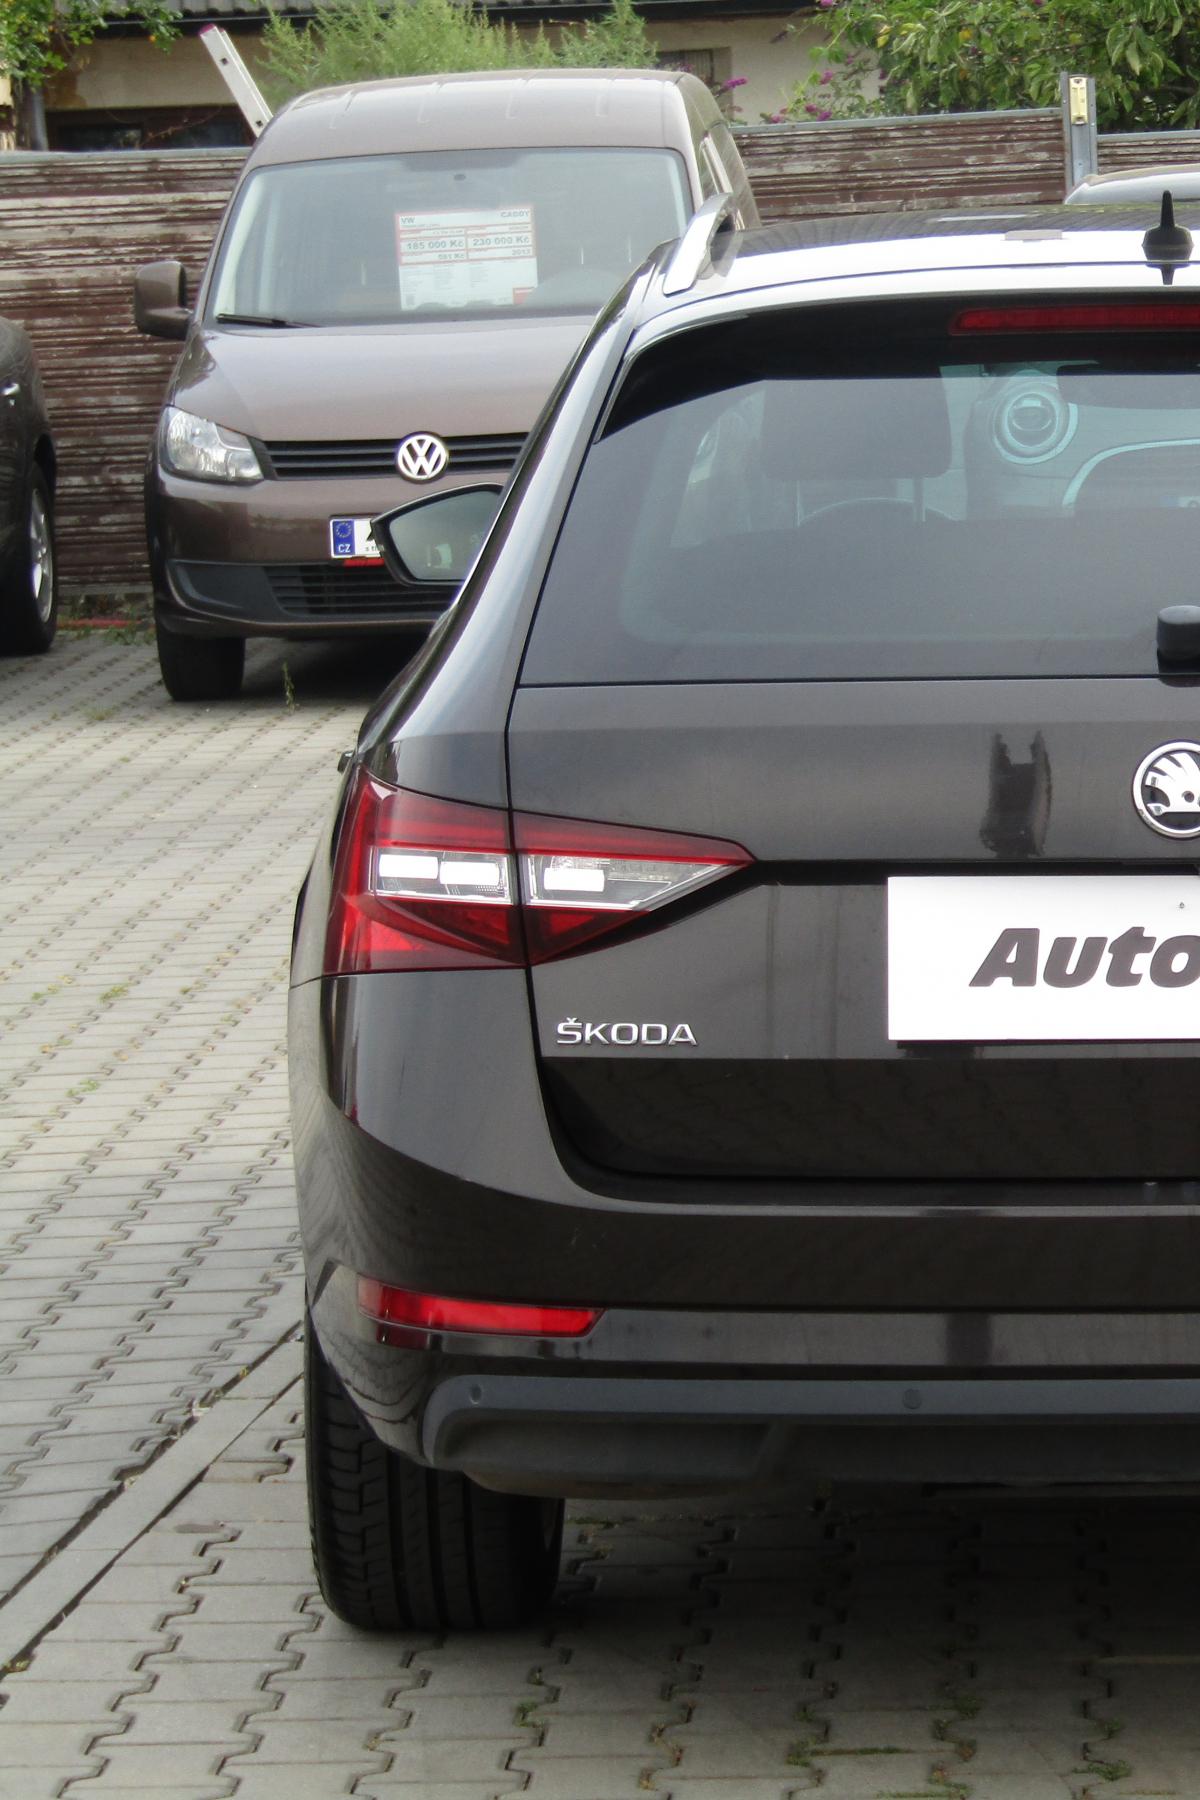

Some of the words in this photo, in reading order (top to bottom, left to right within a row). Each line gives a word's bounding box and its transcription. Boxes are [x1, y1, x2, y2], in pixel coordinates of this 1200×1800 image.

[500, 210, 530, 218] CADDY
[406, 242, 425, 250] 185
[428, 241, 446, 249] 000
[450, 239, 464, 247] Kč
[472, 237, 491, 246] 230
[494, 236, 512, 245] 000
[516, 235, 530, 244] Kč
[398, 434, 447, 479] VW
[338, 543, 351, 553] CZ
[557, 1017, 698, 1046] ŠKODA
